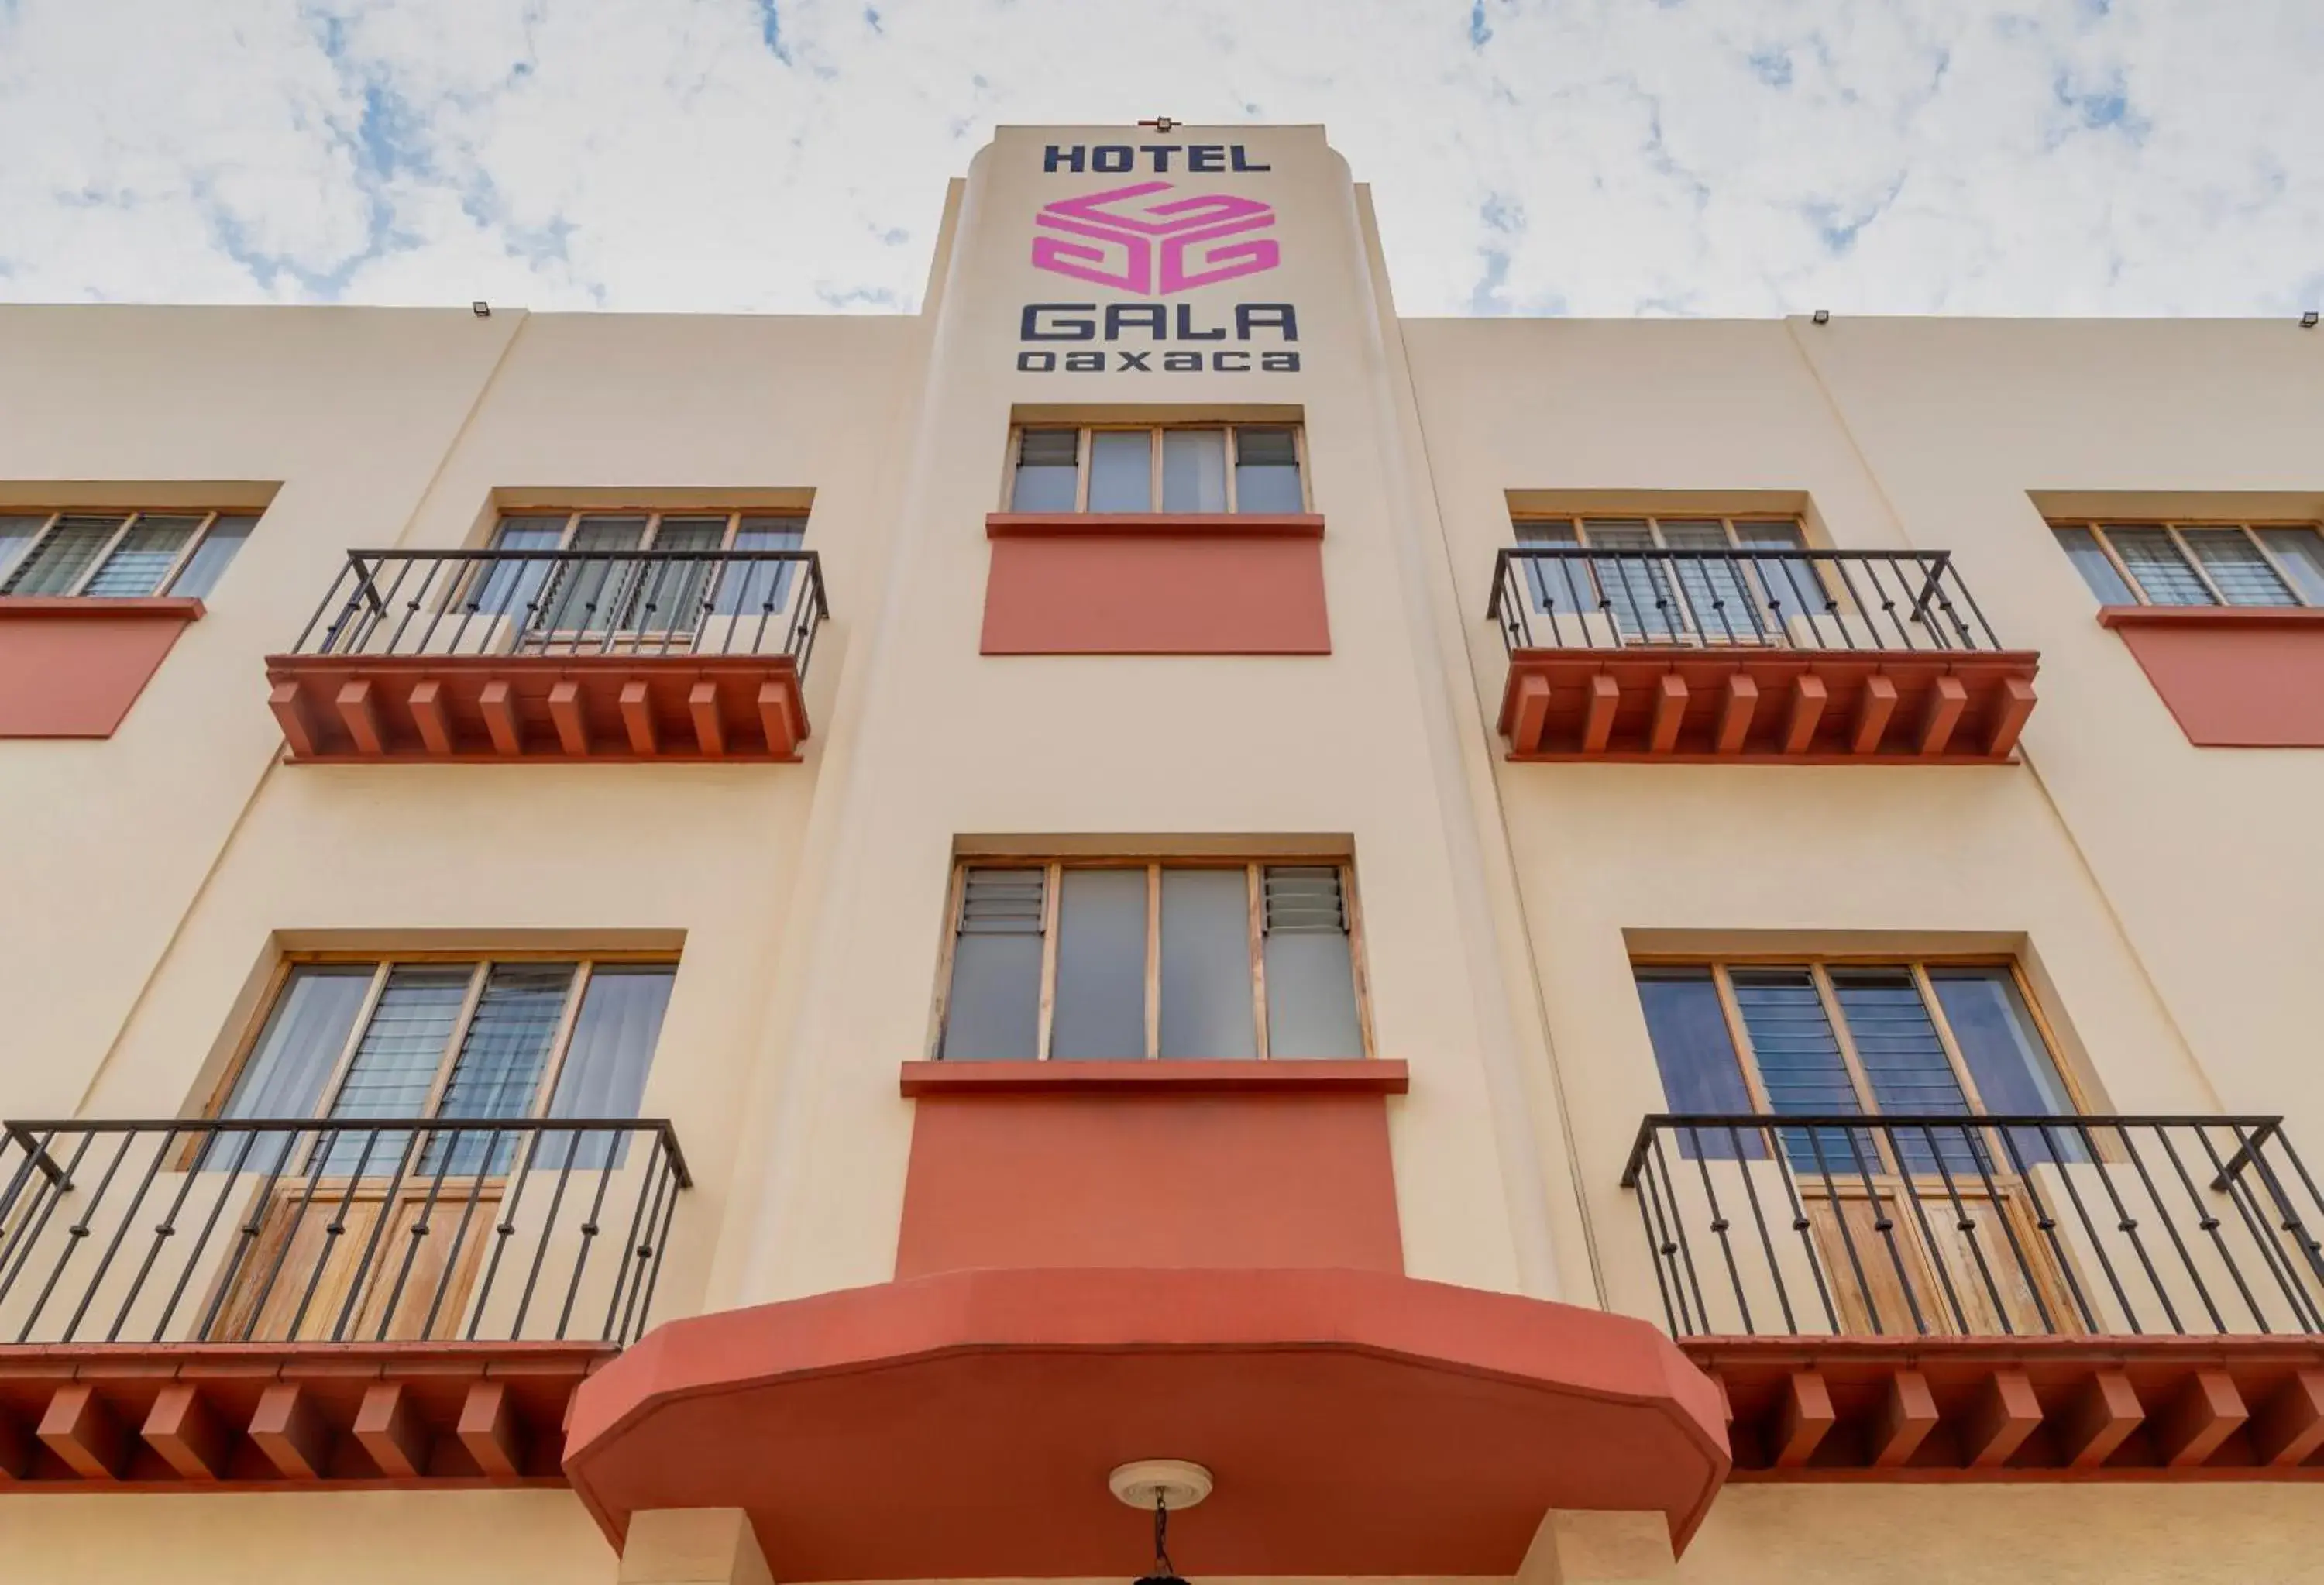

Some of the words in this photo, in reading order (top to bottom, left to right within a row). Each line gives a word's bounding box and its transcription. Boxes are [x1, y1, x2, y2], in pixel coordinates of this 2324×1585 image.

[1043, 145, 1271, 173] HOTEL
[1019, 303, 1298, 342] GALA
[1016, 351, 1301, 373] oaxaca
